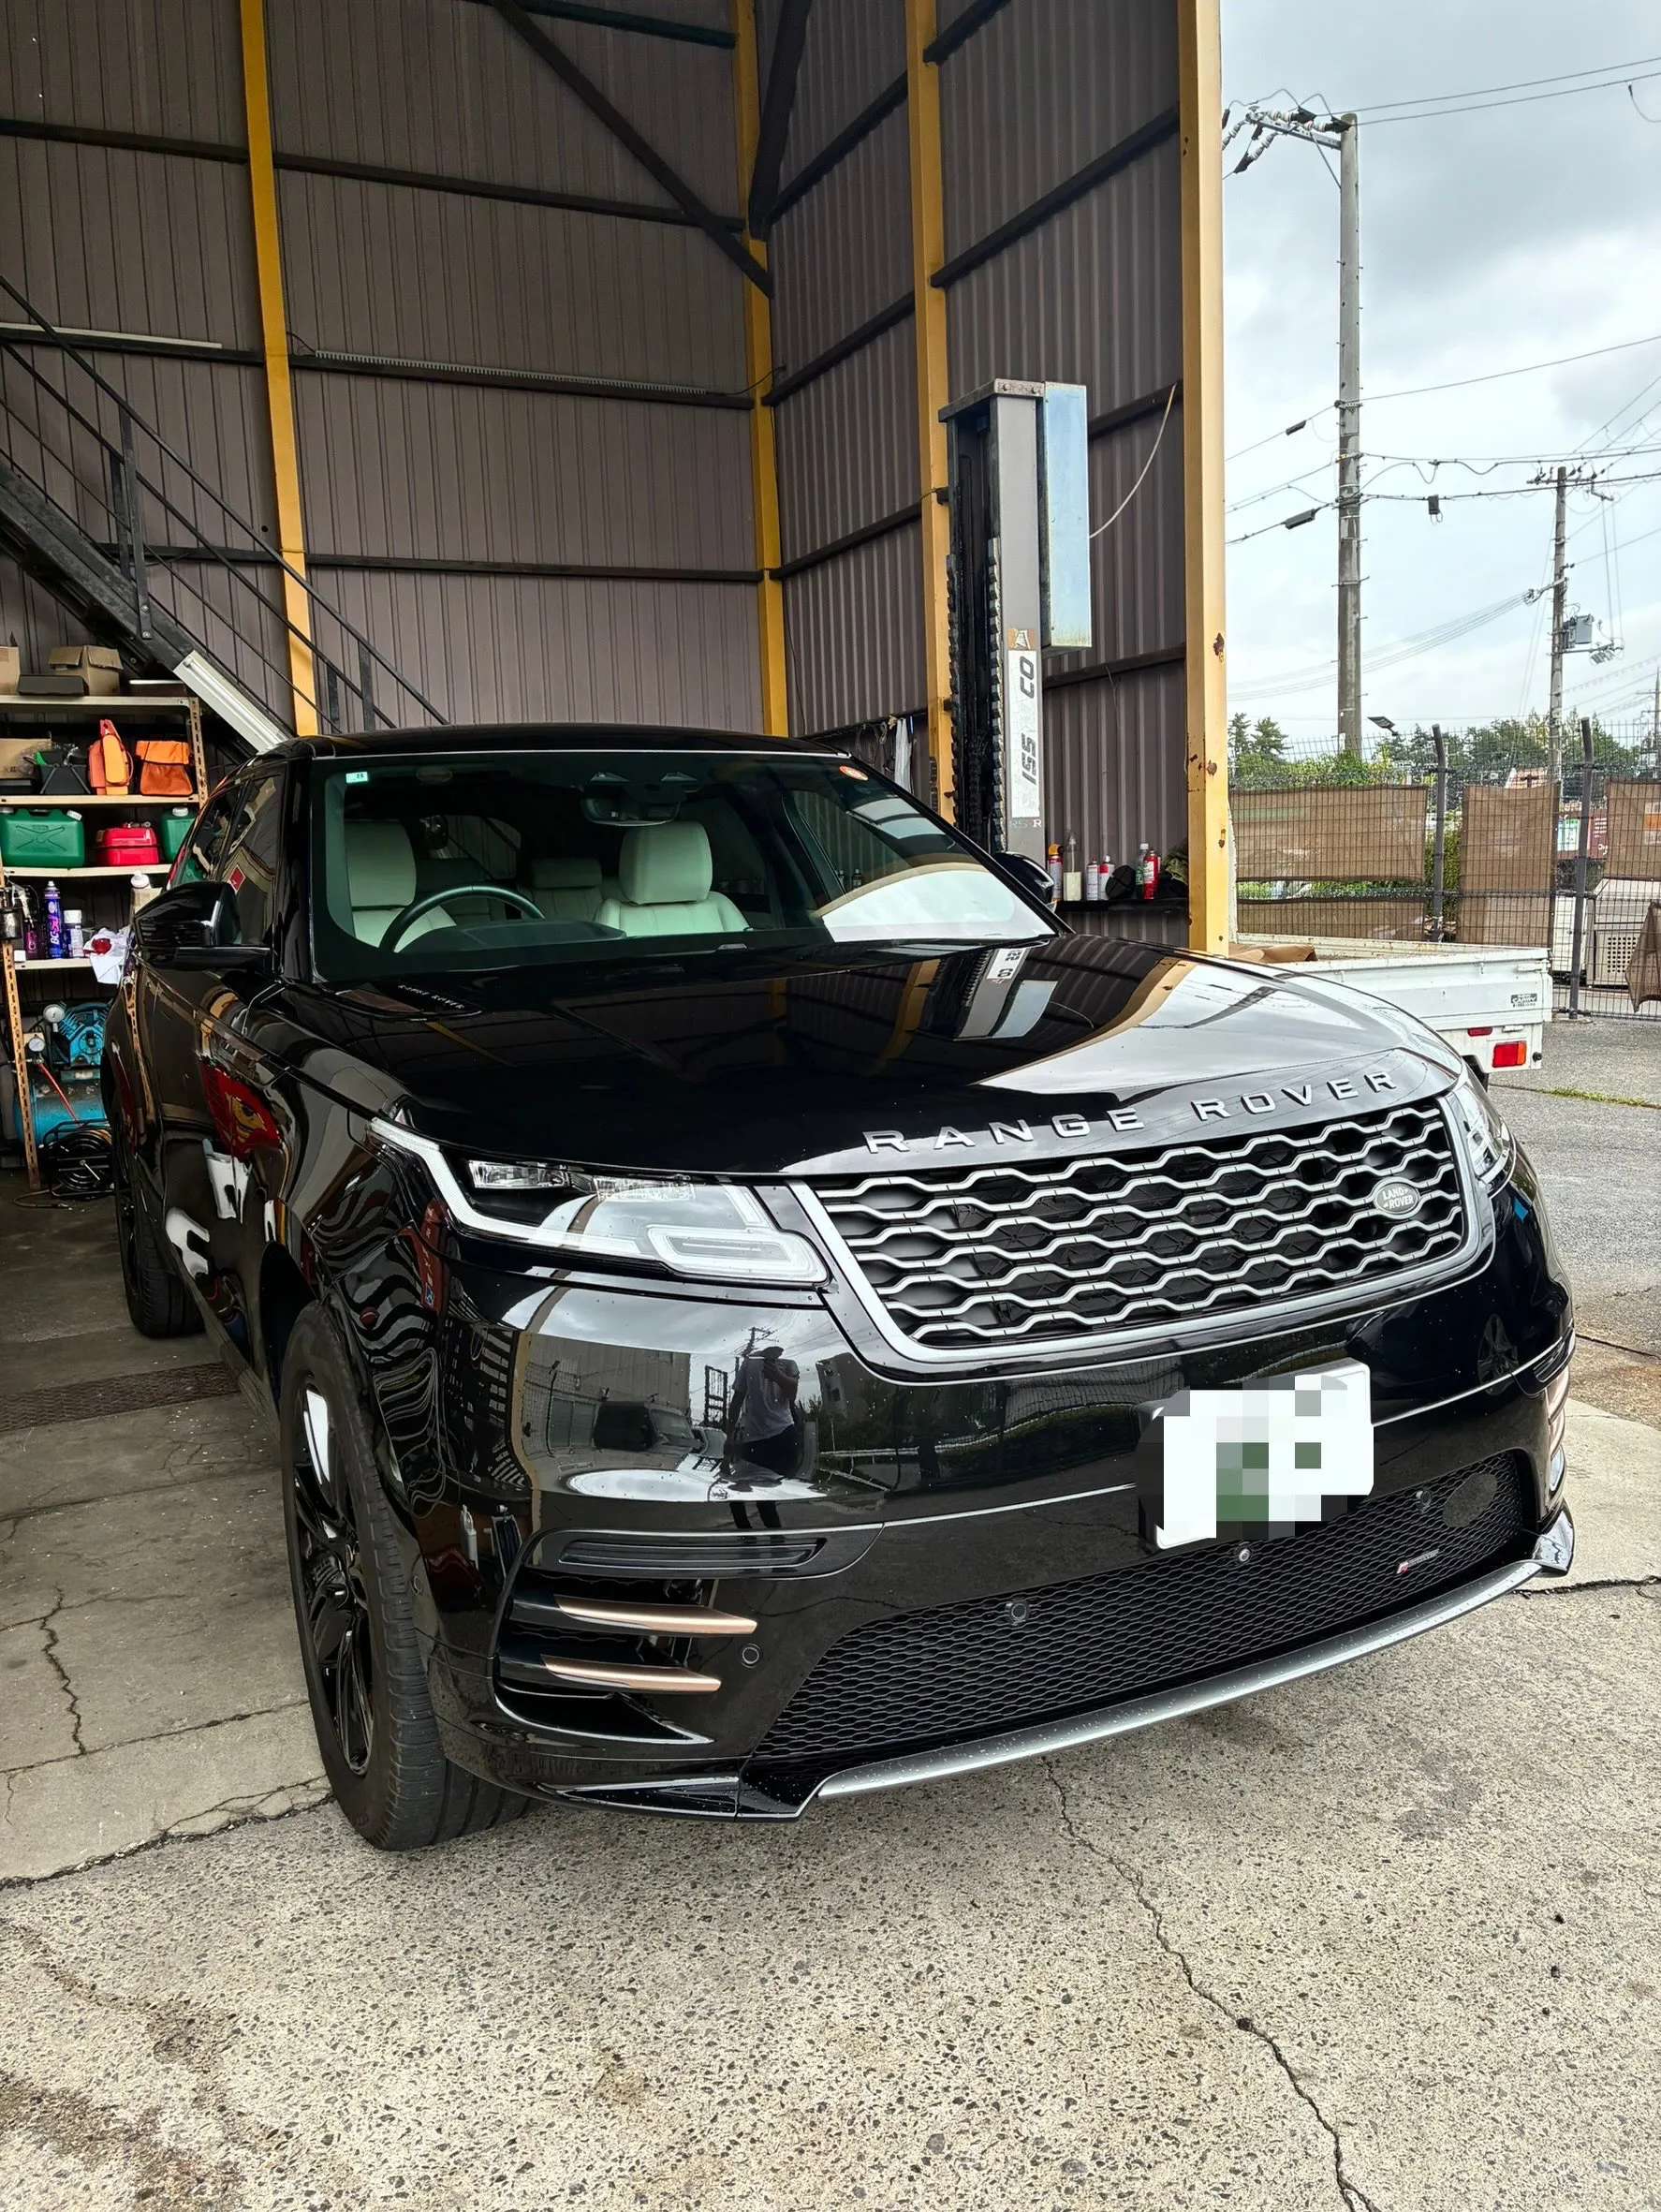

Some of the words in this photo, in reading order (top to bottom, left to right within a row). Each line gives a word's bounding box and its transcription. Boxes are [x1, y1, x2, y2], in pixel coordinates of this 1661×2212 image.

[862, 1107, 1144, 1154] RANGE
[1193, 1070, 1398, 1122] ROVER
[1382, 1187, 1404, 1200] LAND
[1389, 1194, 1414, 1209] ROVER
